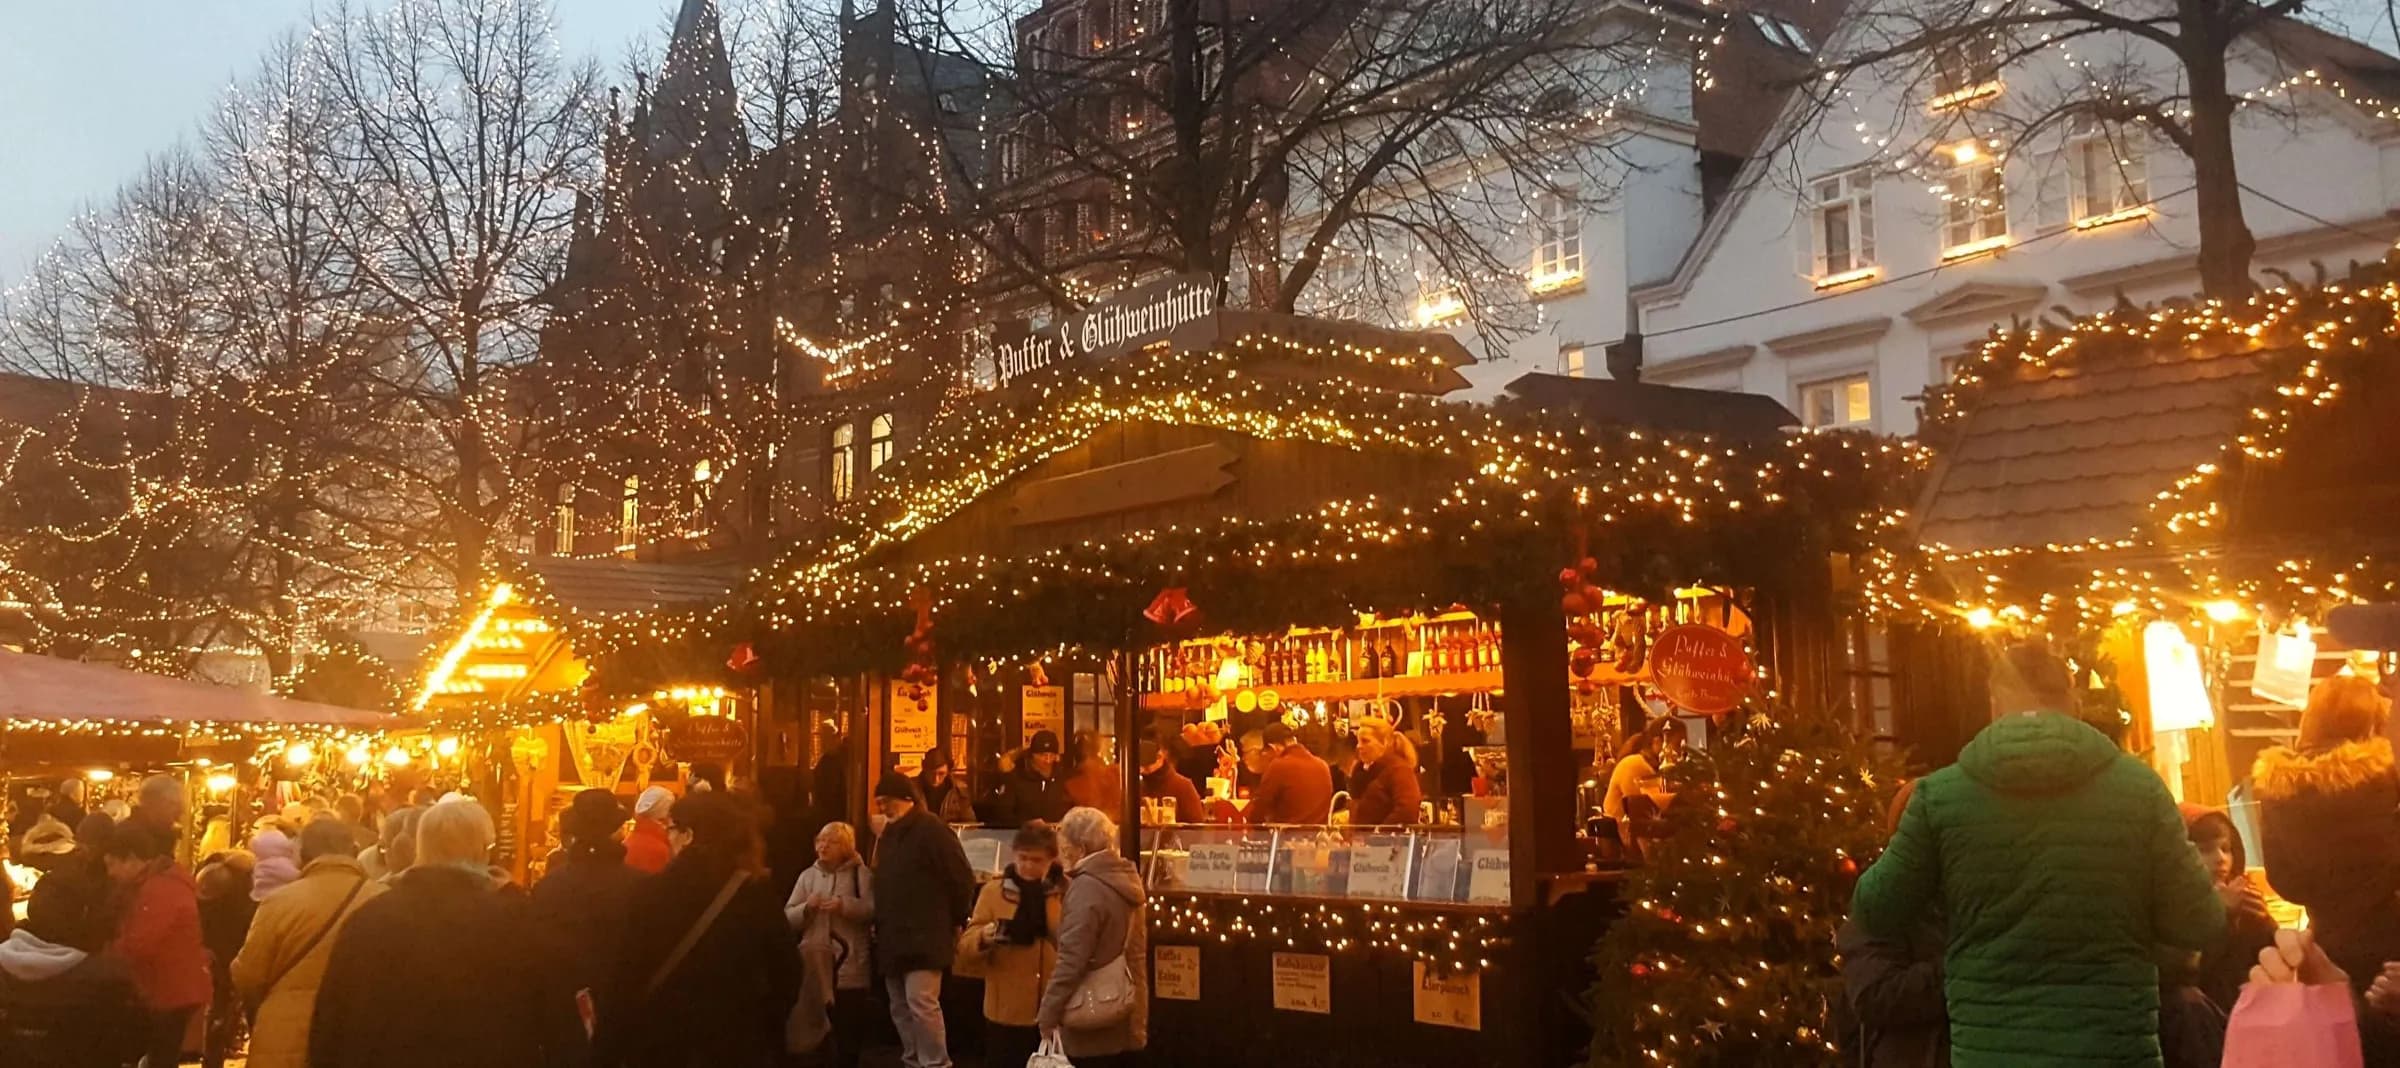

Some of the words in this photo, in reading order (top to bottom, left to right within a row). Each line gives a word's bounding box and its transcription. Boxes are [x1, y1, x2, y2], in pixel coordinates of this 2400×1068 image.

[999, 337, 1052, 389] Puffer
[1059, 321, 1075, 361] &
[1080, 281, 1213, 353] Glühweinhütte
